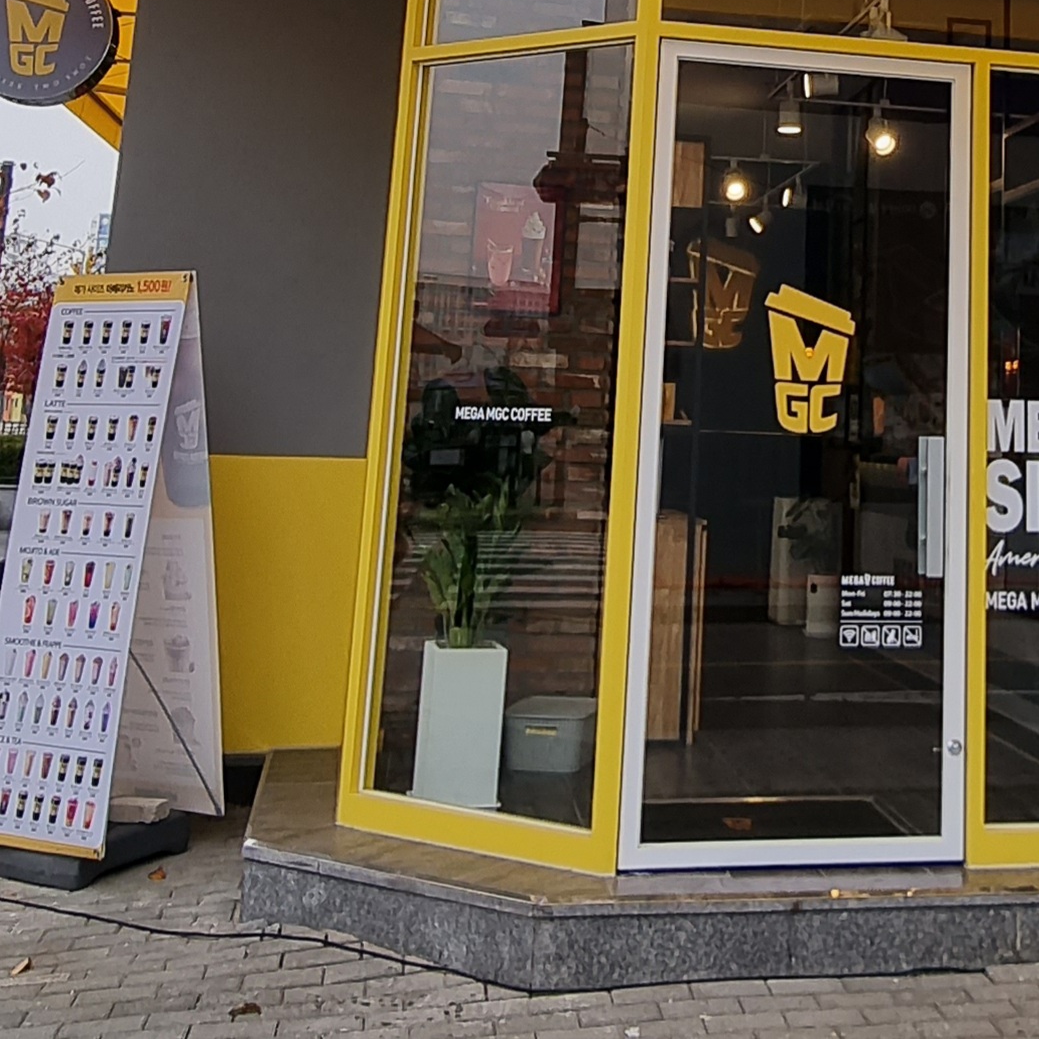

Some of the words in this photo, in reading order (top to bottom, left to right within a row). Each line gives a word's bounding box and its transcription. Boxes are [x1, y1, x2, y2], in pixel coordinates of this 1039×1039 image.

[61, 307, 84, 316] COFFEE
[44, 399, 66, 408] LATTE
[455, 406, 485, 421] MEGA
[486, 407, 510, 422] MGC
[511, 407, 553, 422] COFFEE
[986, 590, 1028, 611] MEGA
